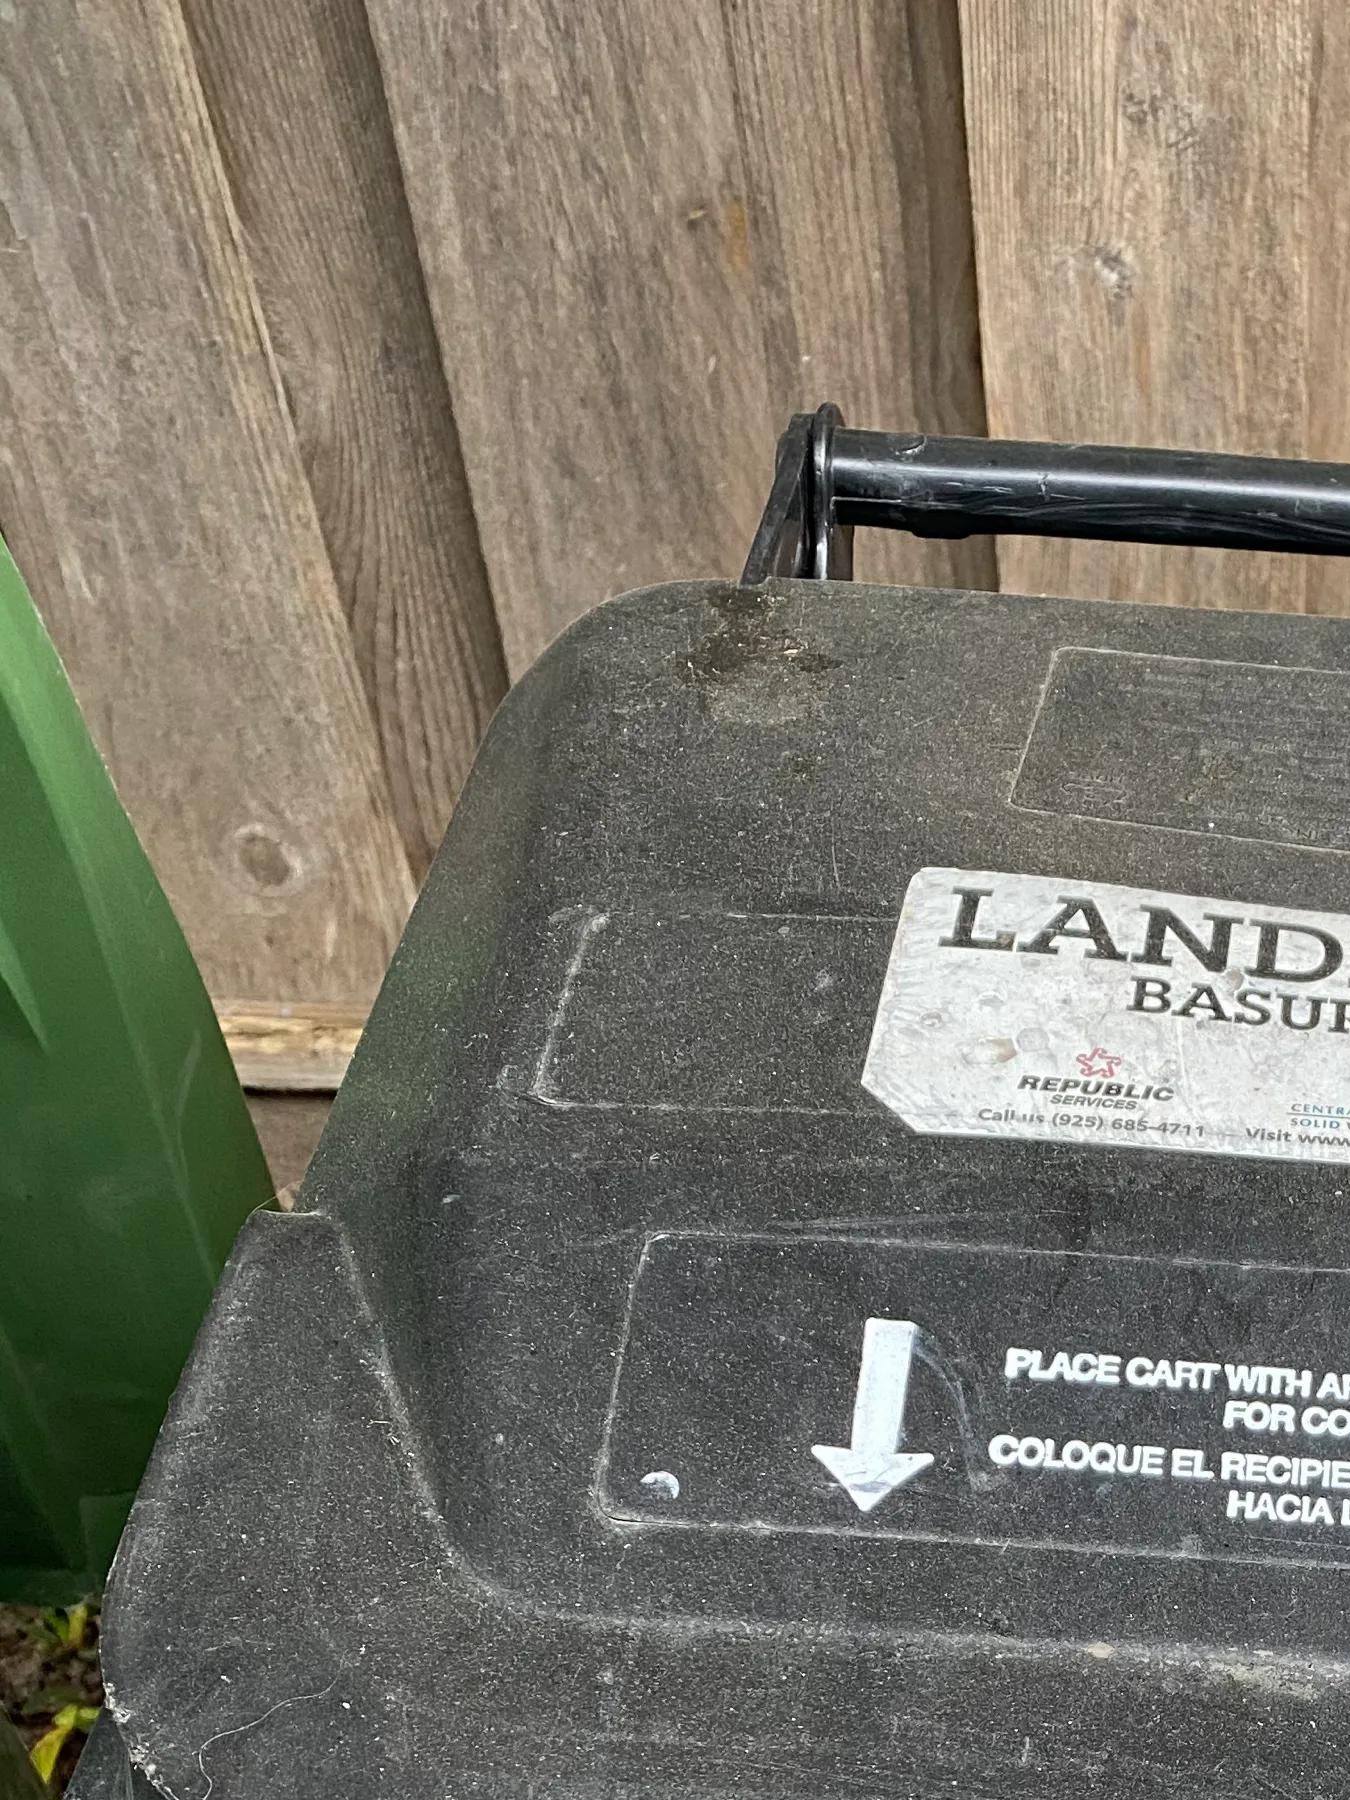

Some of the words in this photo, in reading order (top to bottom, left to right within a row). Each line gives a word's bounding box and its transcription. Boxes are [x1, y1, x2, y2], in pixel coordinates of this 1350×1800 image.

[1017, 1074, 1175, 1102] REPUBLIC
[1050, 1093, 1138, 1111] SERVICES
[978, 1107, 1015, 1123] Call
[1051, 1112, 1105, 1132] (925)
[1111, 1118, 1205, 1138] 685-4711
[1245, 1127, 1292, 1144] Visit
[1290, 1117, 1341, 1131] SOLID
[1003, 1346, 1122, 1386] PLACE
[1125, 1355, 1222, 1391] CART
[1224, 1362, 1313, 1399] WITH
[1222, 1399, 1297, 1433] FOR
[987, 1433, 1166, 1476] COLOQUE
[1171, 1448, 1215, 1480] EL
[1225, 1489, 1335, 1526] HACIA
